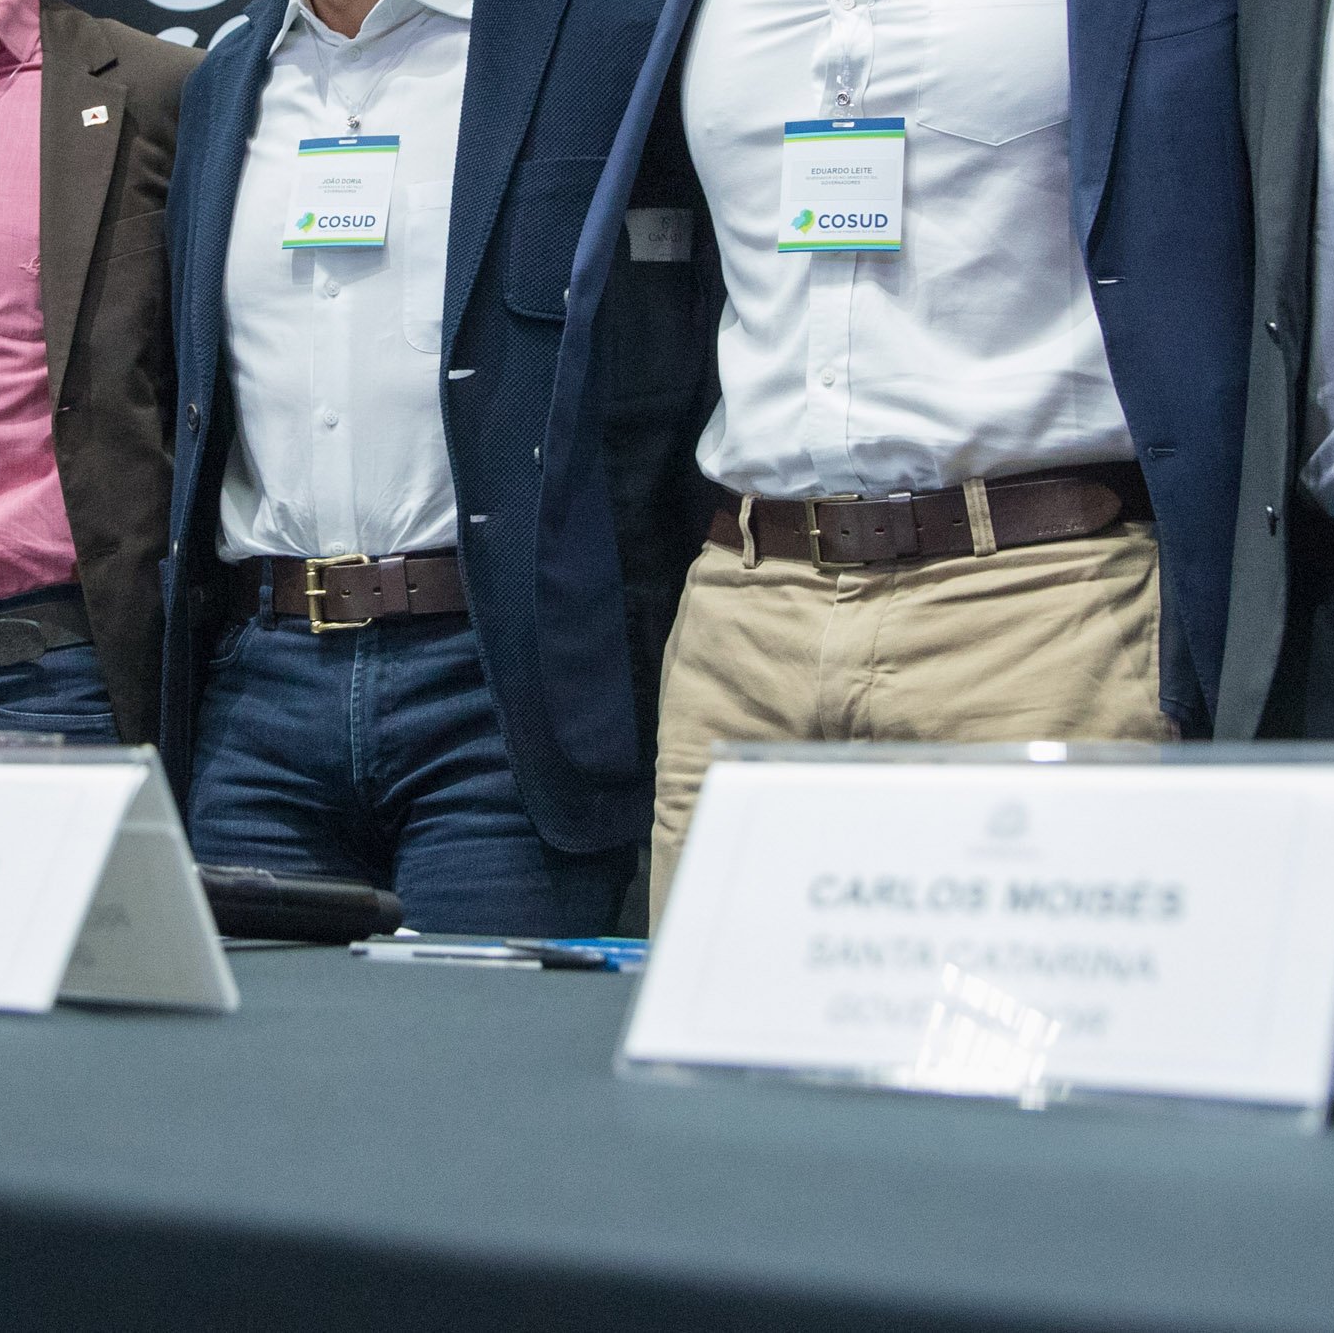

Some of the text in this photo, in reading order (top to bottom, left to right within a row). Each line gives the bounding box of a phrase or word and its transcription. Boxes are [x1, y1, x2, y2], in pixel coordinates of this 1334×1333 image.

[811, 167, 849, 175] EDUARDO
[322, 177, 340, 185] JOÃO
[318, 215, 376, 228] COSUD
[818, 213, 888, 229] COSUD
[806, 871, 992, 913] CARLOS
[806, 934, 936, 973] SANTA
